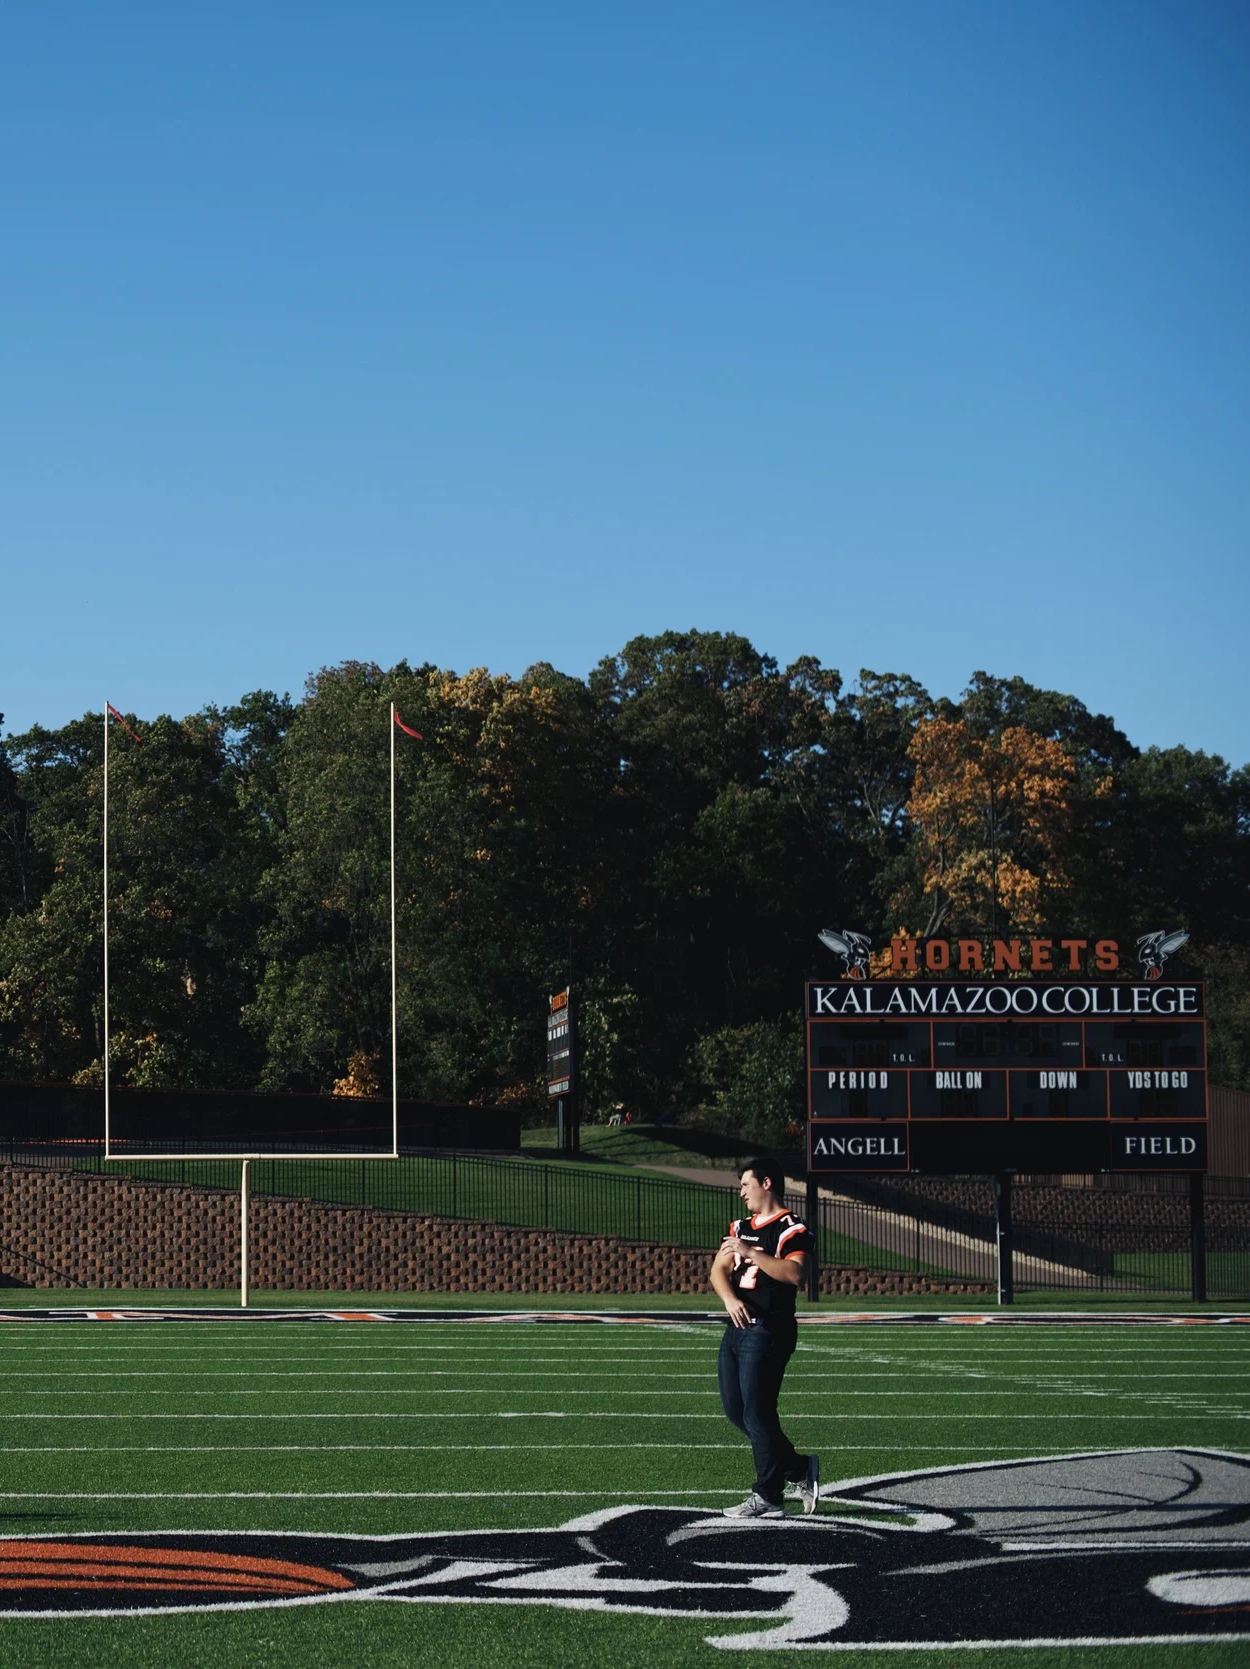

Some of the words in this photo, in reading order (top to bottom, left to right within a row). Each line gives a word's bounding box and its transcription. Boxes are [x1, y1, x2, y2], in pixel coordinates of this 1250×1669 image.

[891, 939, 1120, 971] HORNETS
[813, 986, 1038, 1014] KALAMAZOO
[1041, 986, 1198, 1014] COLLEGE
[828, 1071, 889, 1090] PERIOD
[935, 1071, 963, 1090] BALL
[965, 1071, 983, 1090] ON
[1039, 1071, 1078, 1089] DOWN
[1127, 1071, 1151, 1089] YDS
[1153, 1071, 1169, 1089] TO
[1171, 1071, 1189, 1089] GO
[813, 1137, 906, 1156] ANGELL
[1124, 1137, 1196, 1156] FIELD
